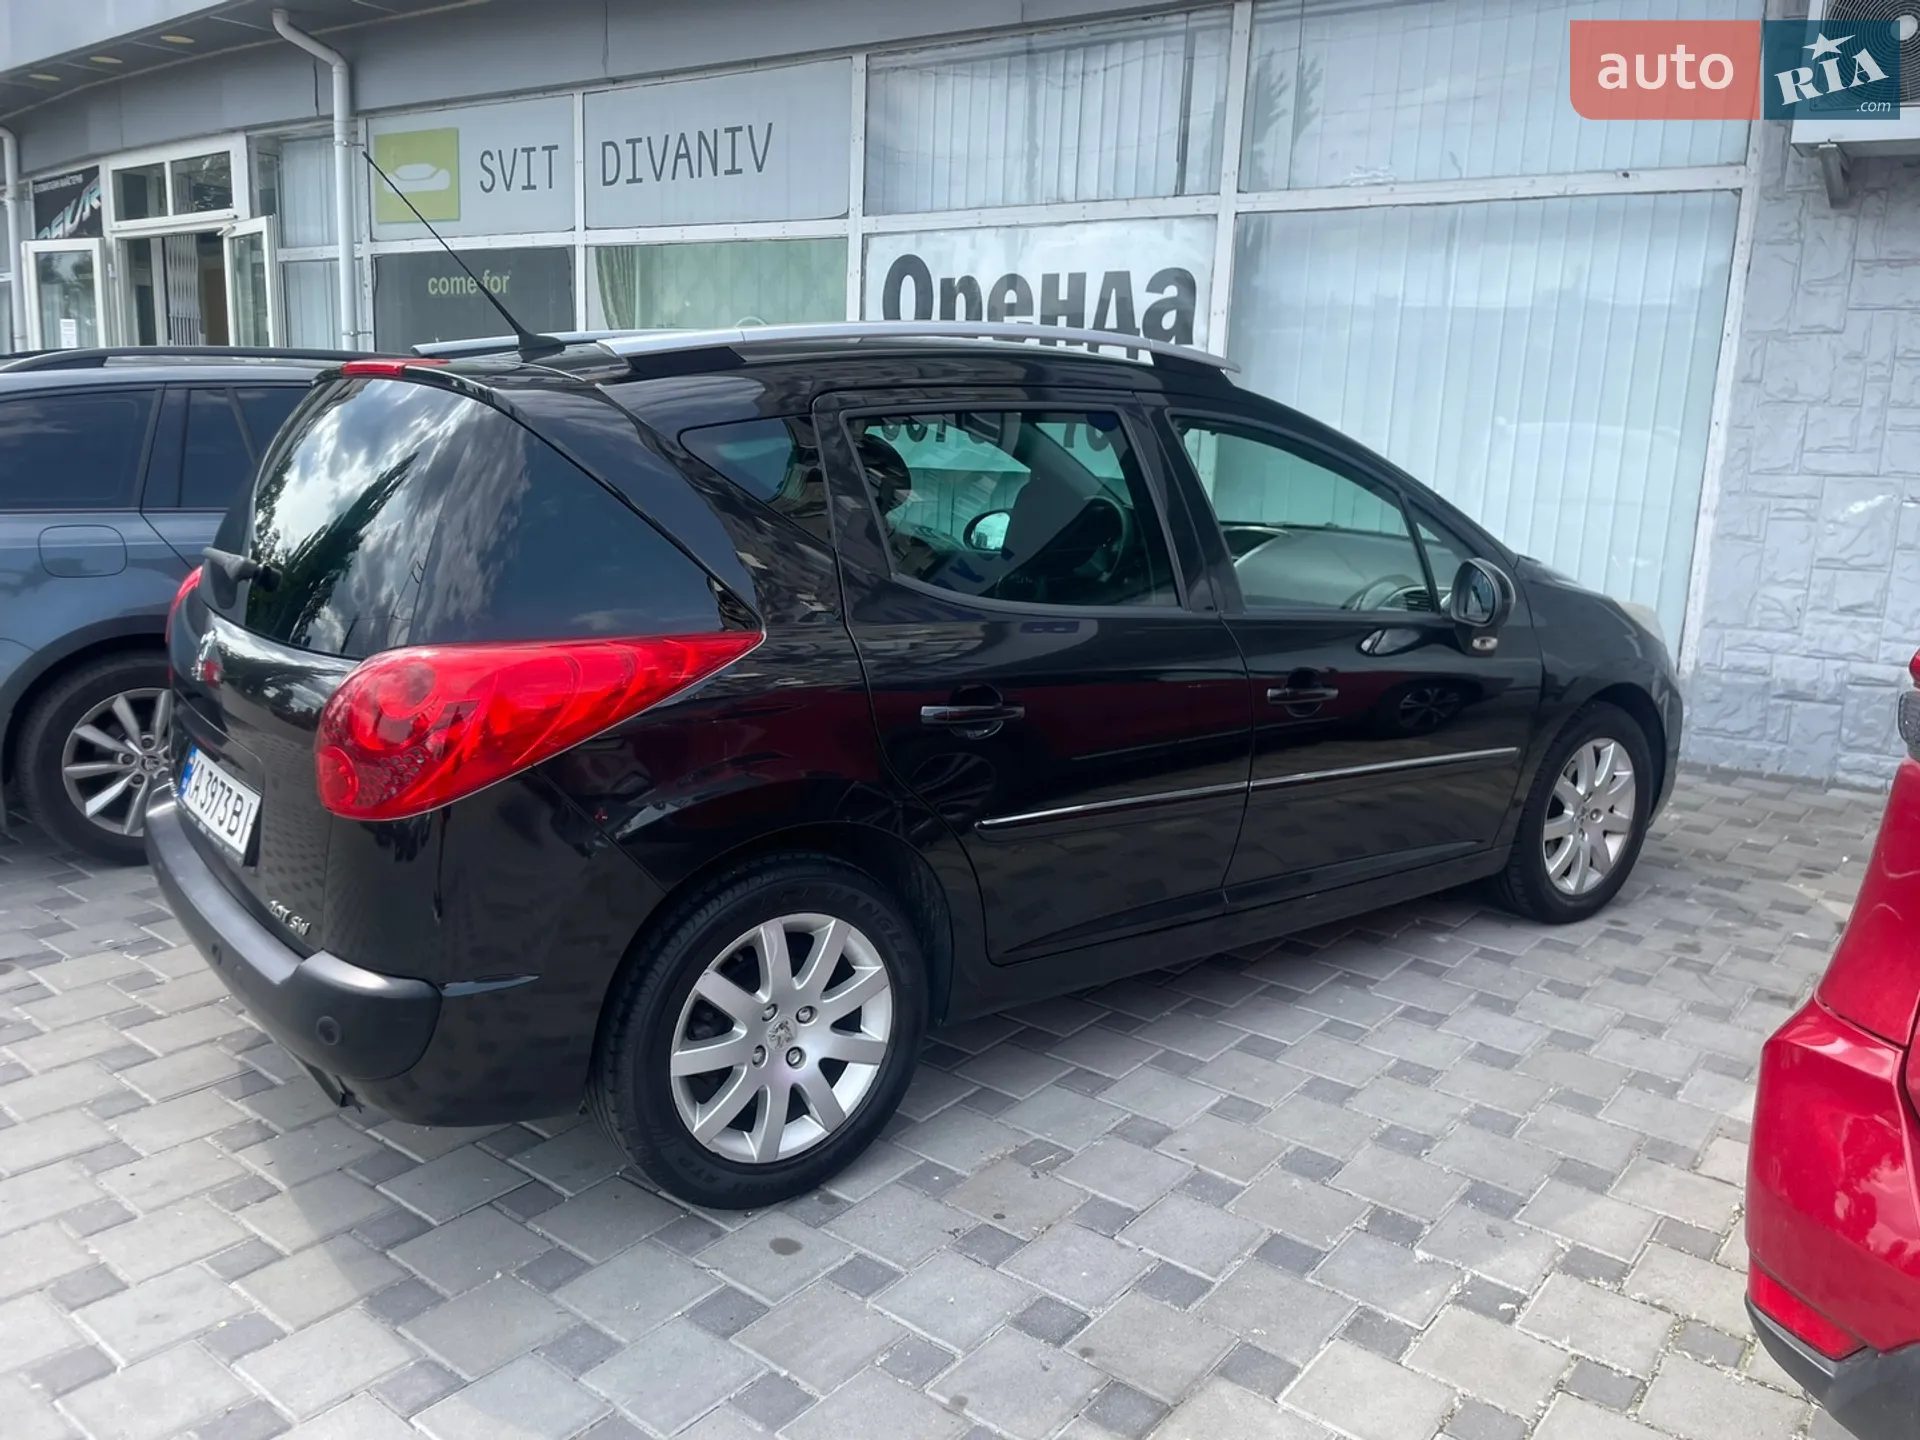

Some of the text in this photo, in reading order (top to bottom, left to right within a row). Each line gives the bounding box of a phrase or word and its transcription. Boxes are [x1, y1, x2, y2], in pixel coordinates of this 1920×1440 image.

[479, 122, 773, 194] SVIT DIVANIV
[428, 269, 510, 295] come for
